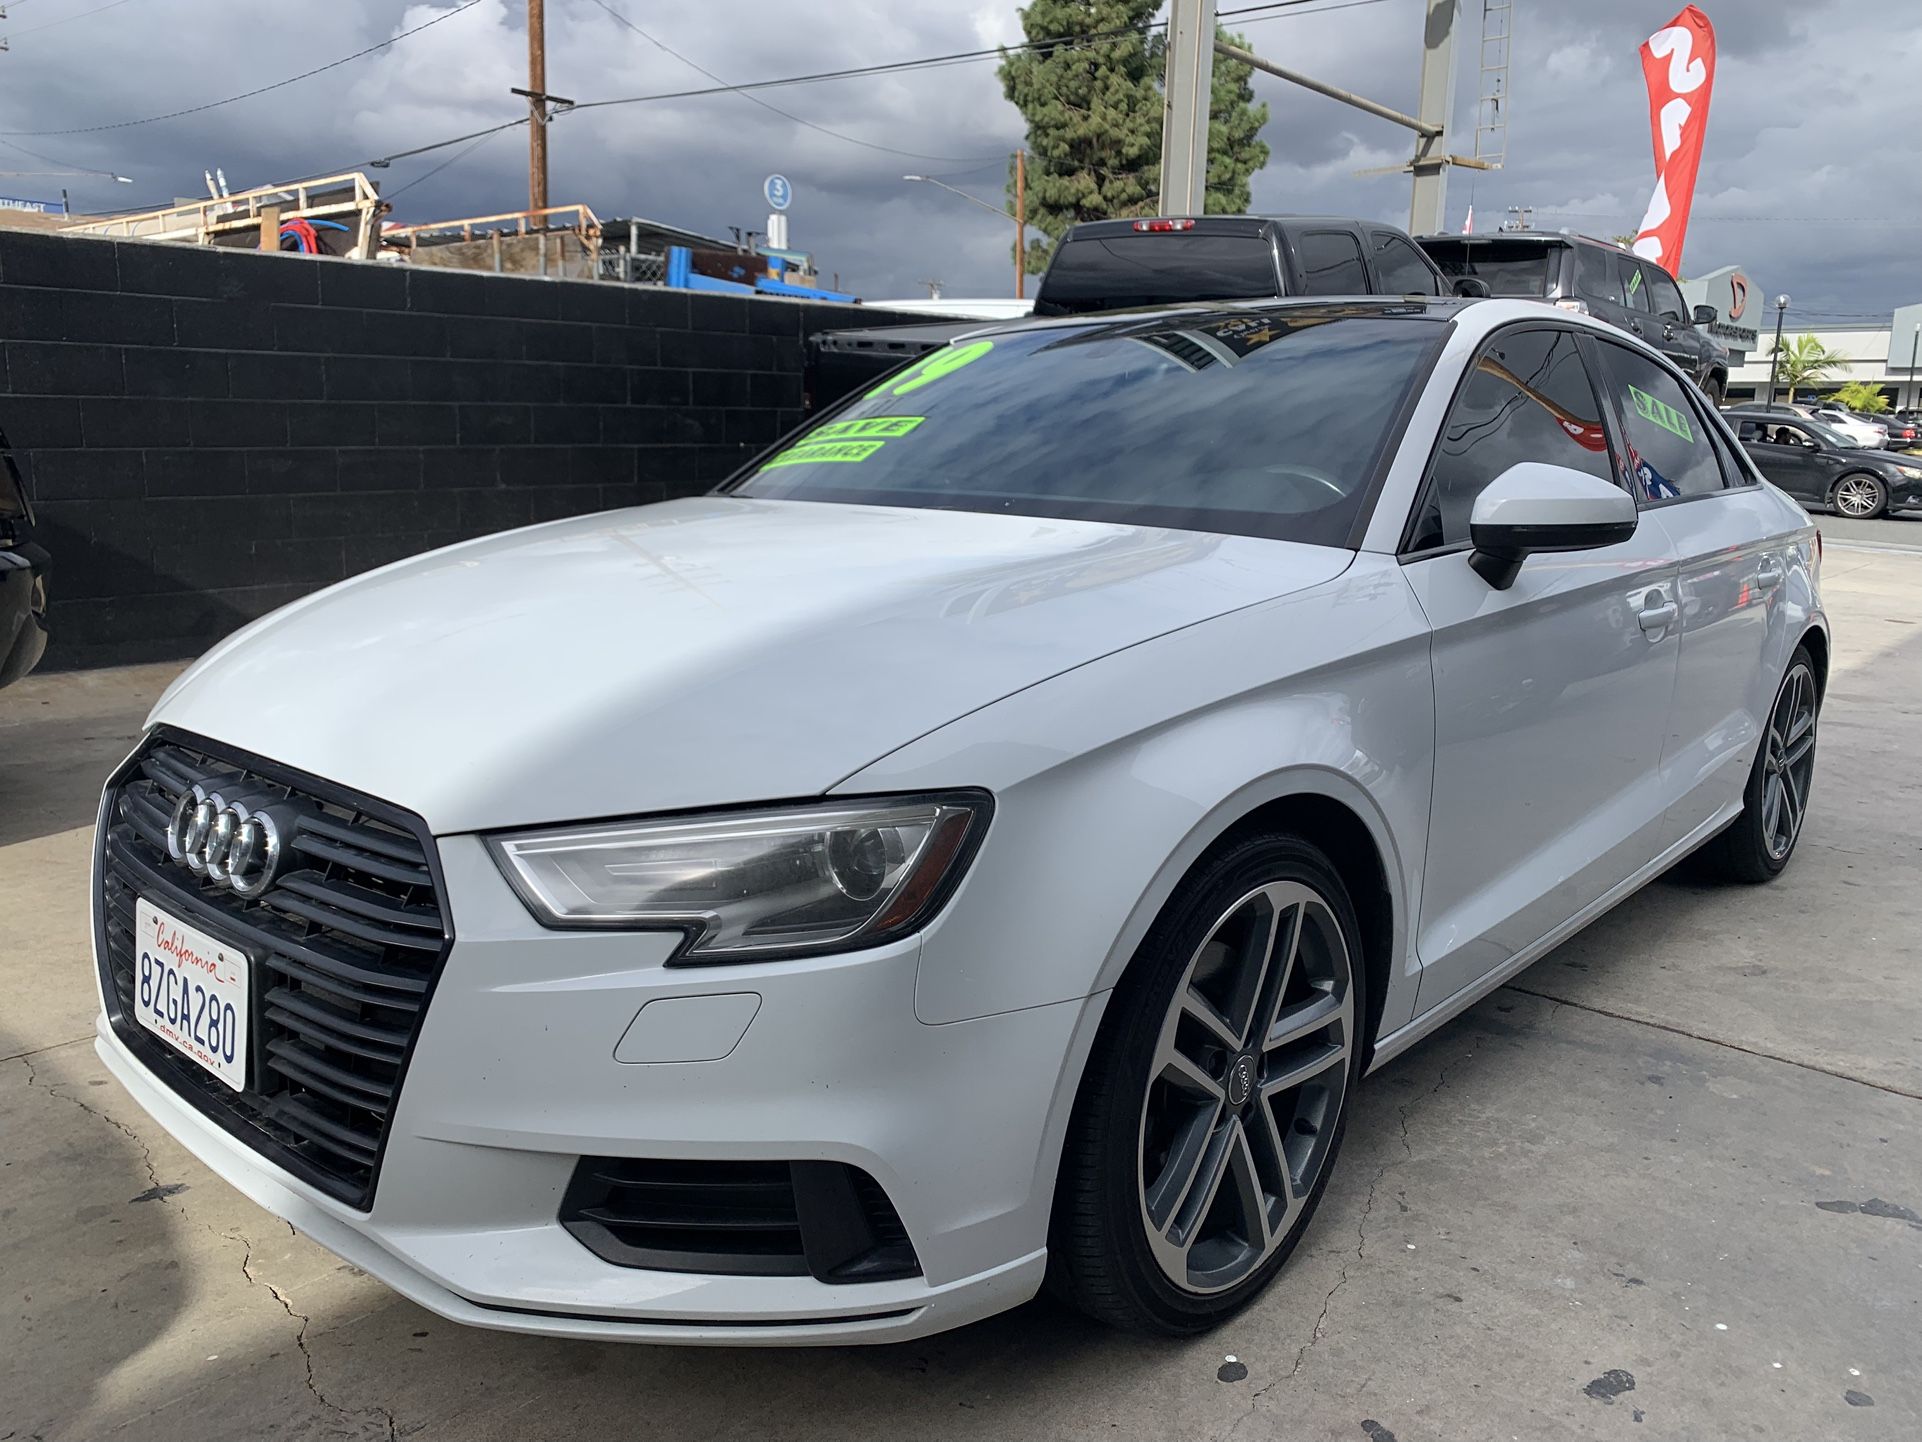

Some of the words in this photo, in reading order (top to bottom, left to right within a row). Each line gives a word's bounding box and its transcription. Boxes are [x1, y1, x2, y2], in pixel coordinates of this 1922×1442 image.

[1632, 390, 1689, 436] SALE
[156, 922, 225, 984] California
[140, 951, 236, 1064] 8ZGA280
[159, 1023, 216, 1067] dmv.ca.gov
